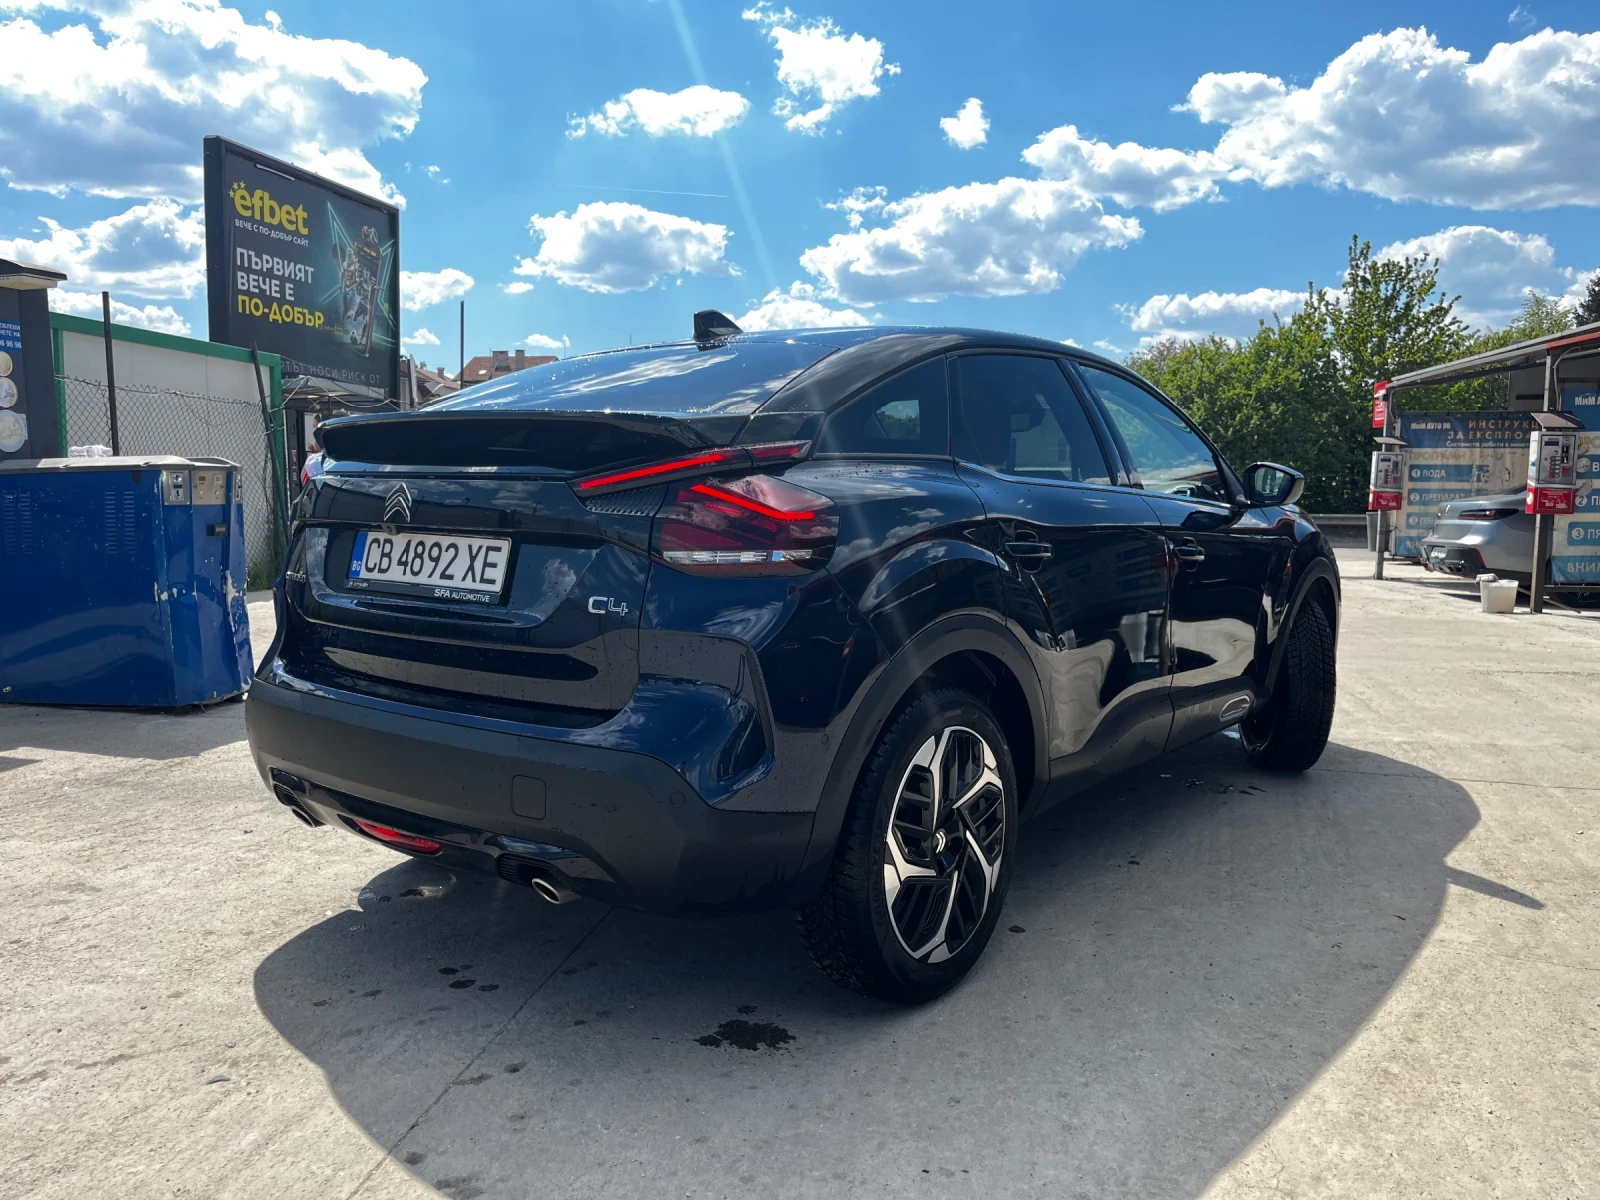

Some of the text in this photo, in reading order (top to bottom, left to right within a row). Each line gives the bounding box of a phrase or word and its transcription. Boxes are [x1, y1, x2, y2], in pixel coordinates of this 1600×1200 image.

[234, 188, 309, 235] efbet
[235, 218, 309, 247] ВЕЧЕ С ПО-ДОБЪР САЙТ
[236, 247, 315, 284] ПЪРВИЯТ
[237, 271, 295, 301] ВЕЧЕ Е
[238, 294, 324, 328] ПО-ДОБЪР
[342, 369, 366, 382] РИСК
[369, 374, 380, 384] ОТ
[1447, 431, 1464, 440] ЗА
[1422, 469, 1446, 478] ВОДА
[1422, 493, 1465, 501] ПРЕПАРАТ
[352, 560, 362, 571] BG
[364, 537, 503, 585] CB 4892 XE
[434, 588, 490, 602] SFA AUTOMOTIVE
[587, 595, 629, 616] C4
